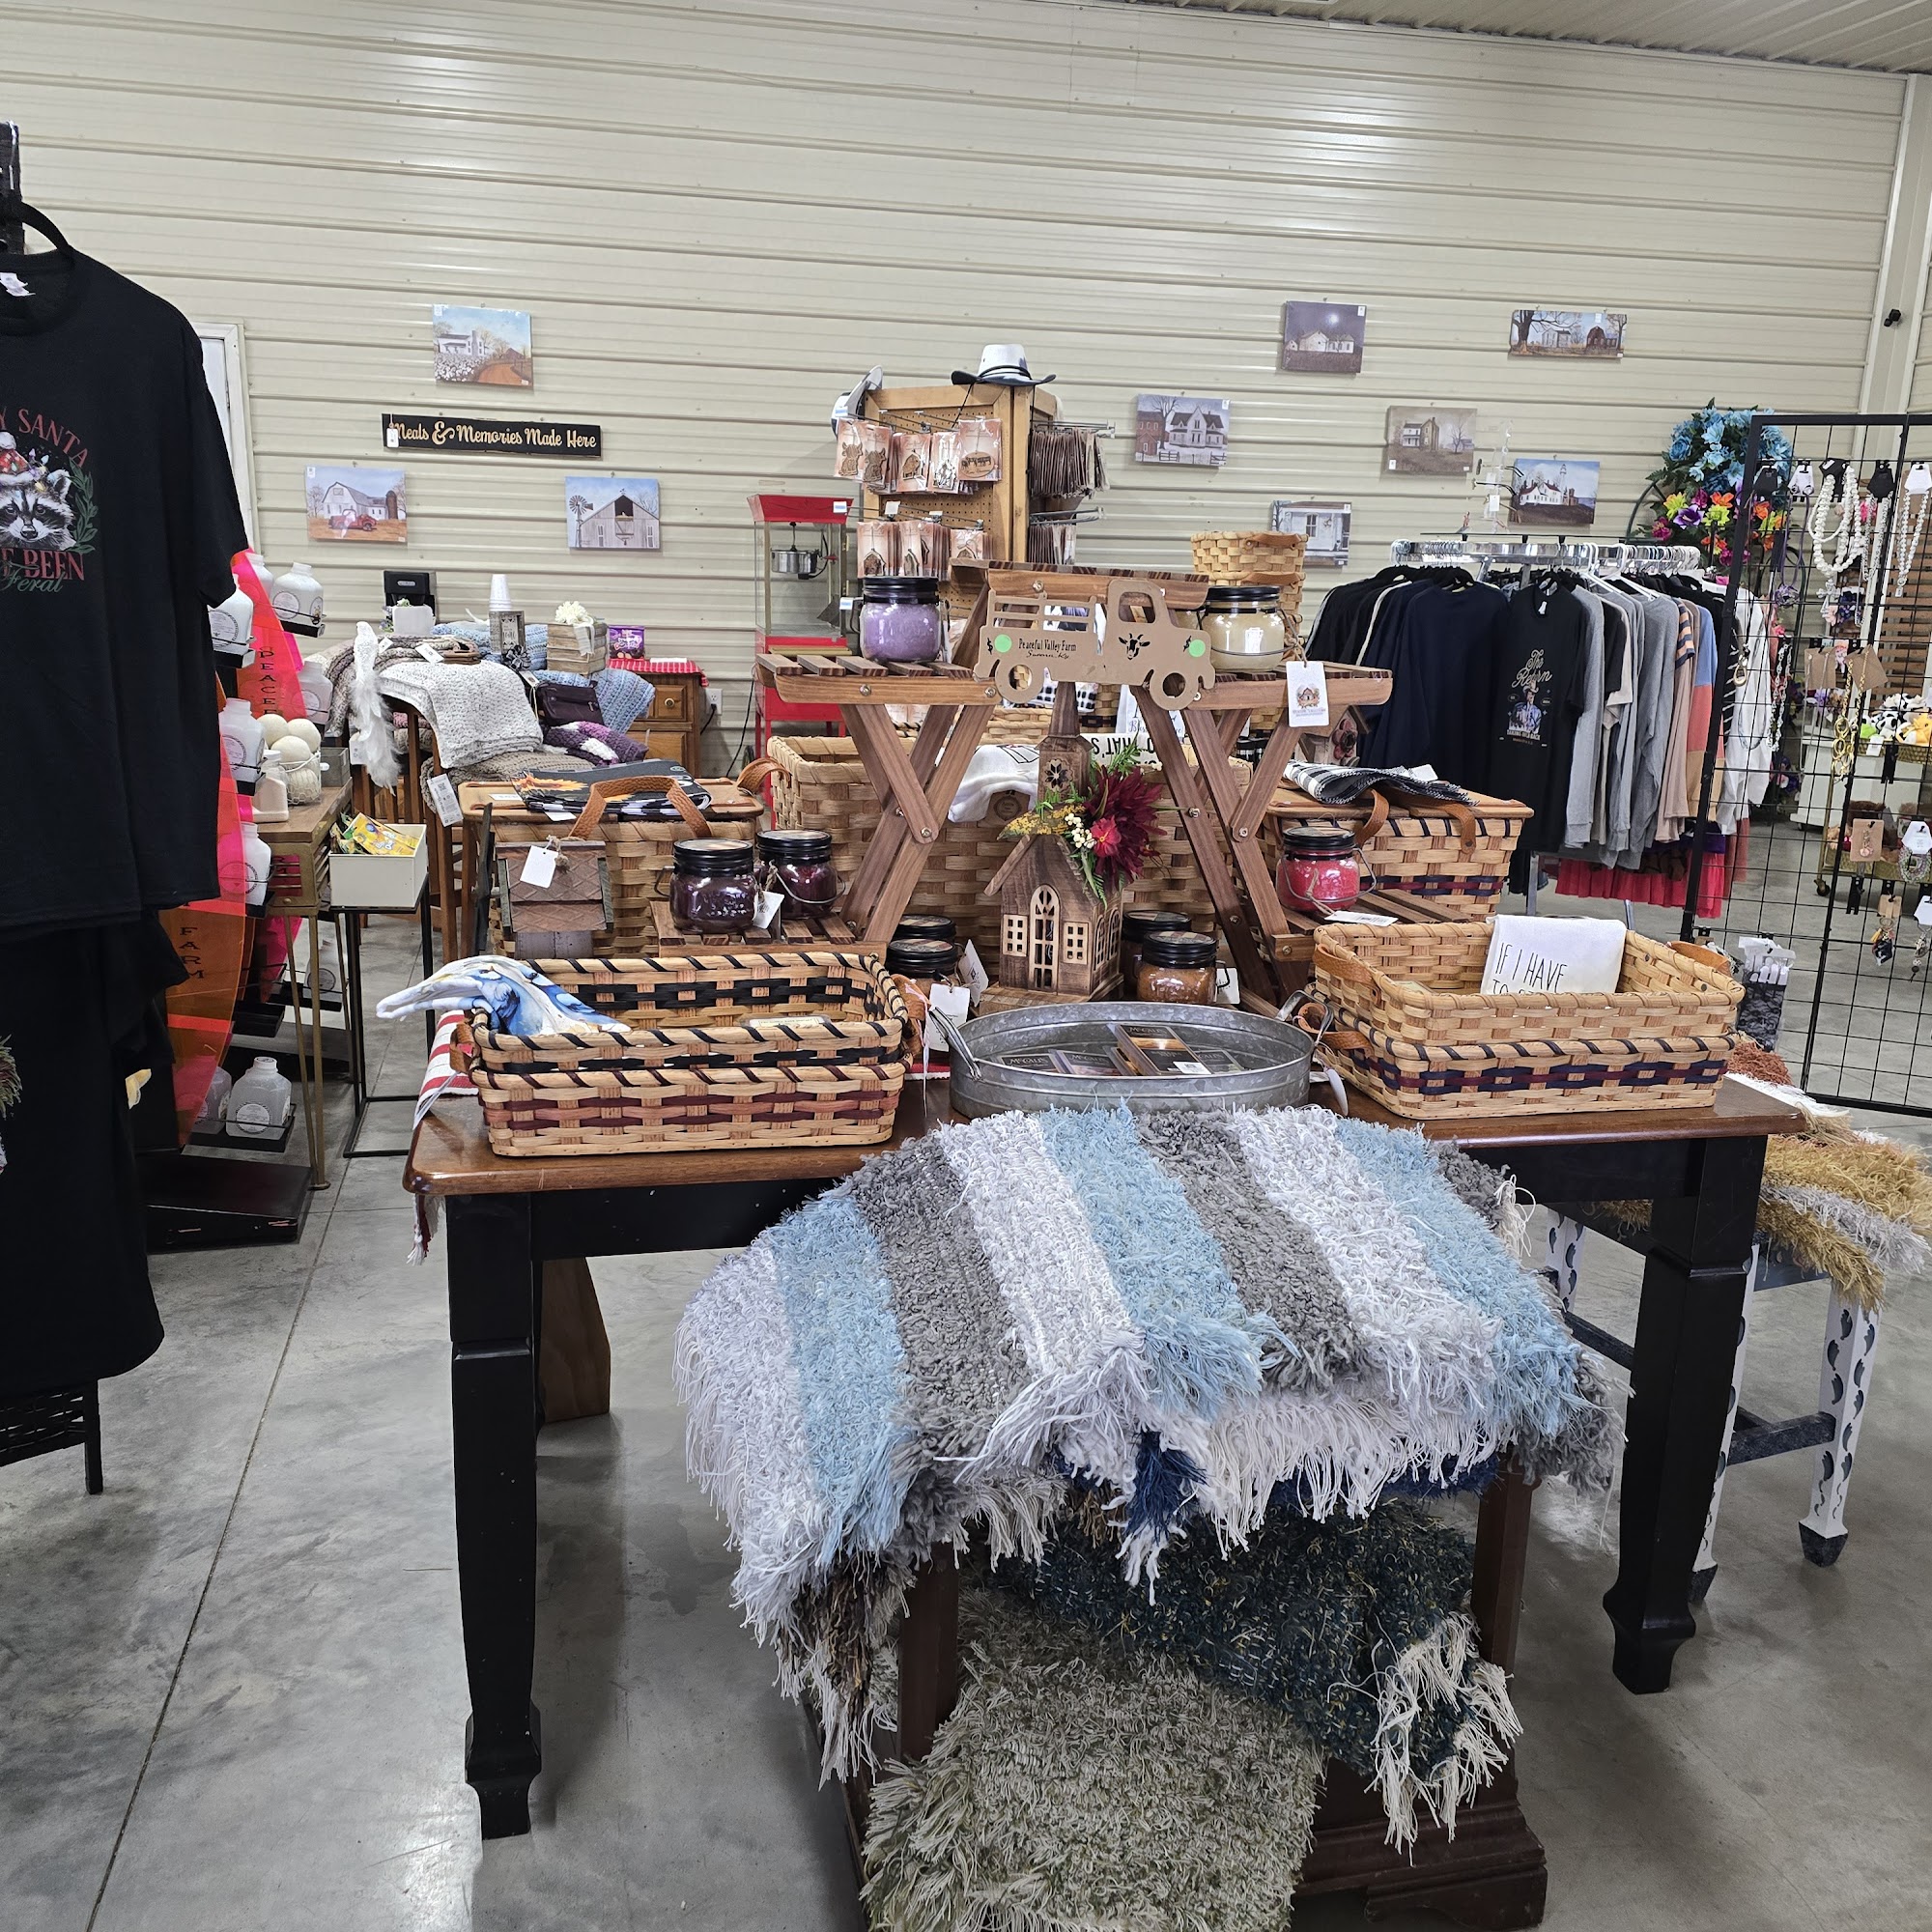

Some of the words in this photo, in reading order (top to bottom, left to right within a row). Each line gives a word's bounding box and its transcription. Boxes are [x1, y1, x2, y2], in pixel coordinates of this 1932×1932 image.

[18, 409, 88, 468] SANTA
[432, 421, 455, 445] &
[456, 425, 523, 445] Memories
[525, 428, 563, 447] Made
[566, 430, 597, 448] Here
[23, 549, 85, 581] BEEN
[1018, 638, 1043, 650] Peaceful
[1044, 639, 1062, 653] Valley
[1061, 639, 1077, 652] Farm
[1494, 942, 1513, 975] IF
[1511, 949, 1522, 980] I
[1523, 952, 1568, 994] HAVE
